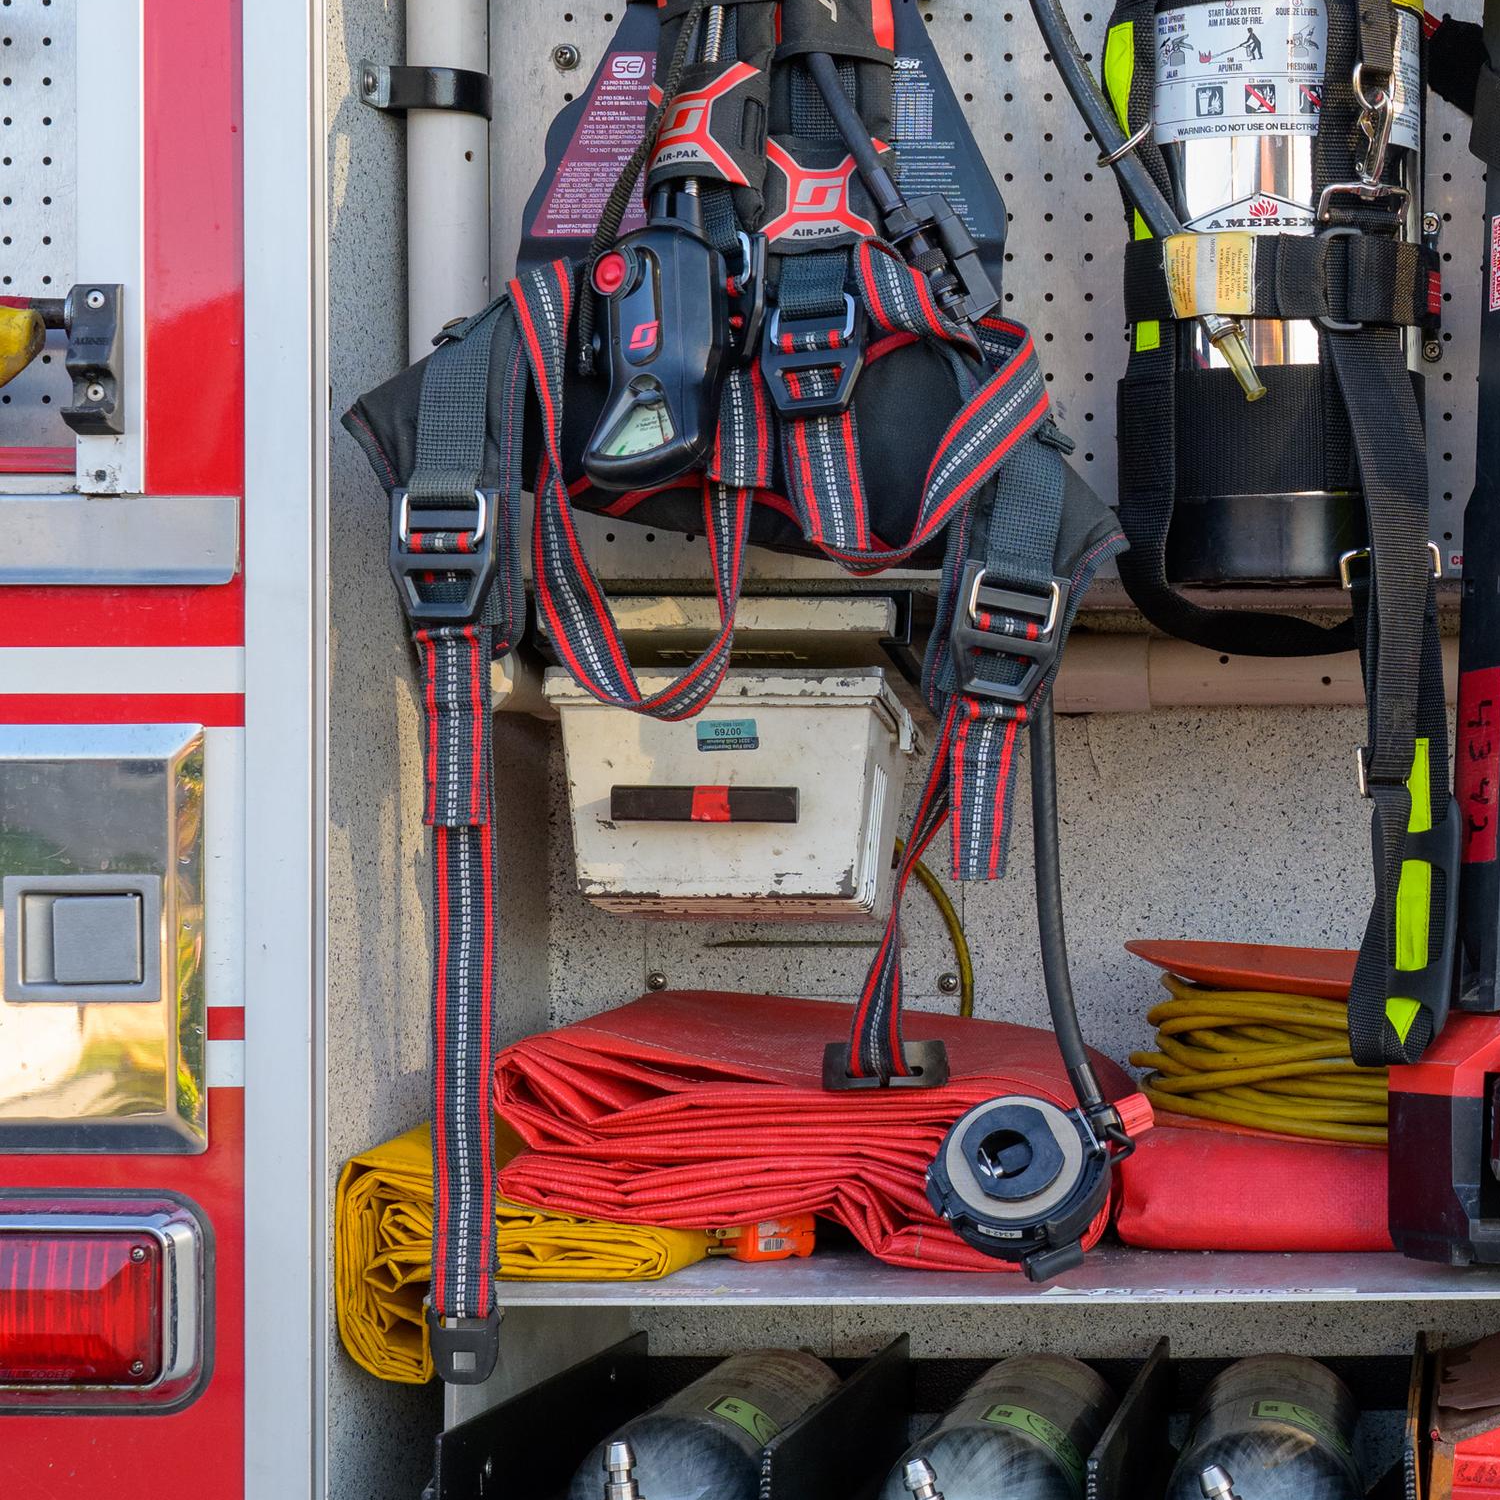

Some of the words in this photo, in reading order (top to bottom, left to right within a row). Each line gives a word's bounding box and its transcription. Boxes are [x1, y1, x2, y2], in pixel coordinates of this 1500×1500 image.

[1208, 9, 1225, 18] START
[1226, 8, 1239, 17] BACK
[1240, 7, 1247, 16] 20
[1248, 7, 1263, 15] FEET.
[1276, 7, 1300, 16] SQUEZE
[1301, 7, 1319, 16] LEVER.
[1208, 19, 1218, 27] AIM
[1219, 18, 1226, 26] AT
[1227, 17, 1241, 26] BASE
[1242, 17, 1248, 25] OF
[1249, 16, 1264, 25] FIRE.
[1158, 26, 1167, 35] PULL
[1168, 24, 1177, 34] RING
[613, 60, 645, 73] SEI
[1218, 64, 1243, 73] APUNTAR
[1177, 126, 1214, 136] WARNING:
[1215, 124, 1226, 133] DO
[1228, 124, 1246, 132] NOT
[1247, 123, 1263, 131] USE
[1265, 123, 1279, 131] ON
[656, 150, 699, 163] AIR-PAK
[792, 226, 840, 237] AIR-PAK
[714, 728, 741, 736] 00769
